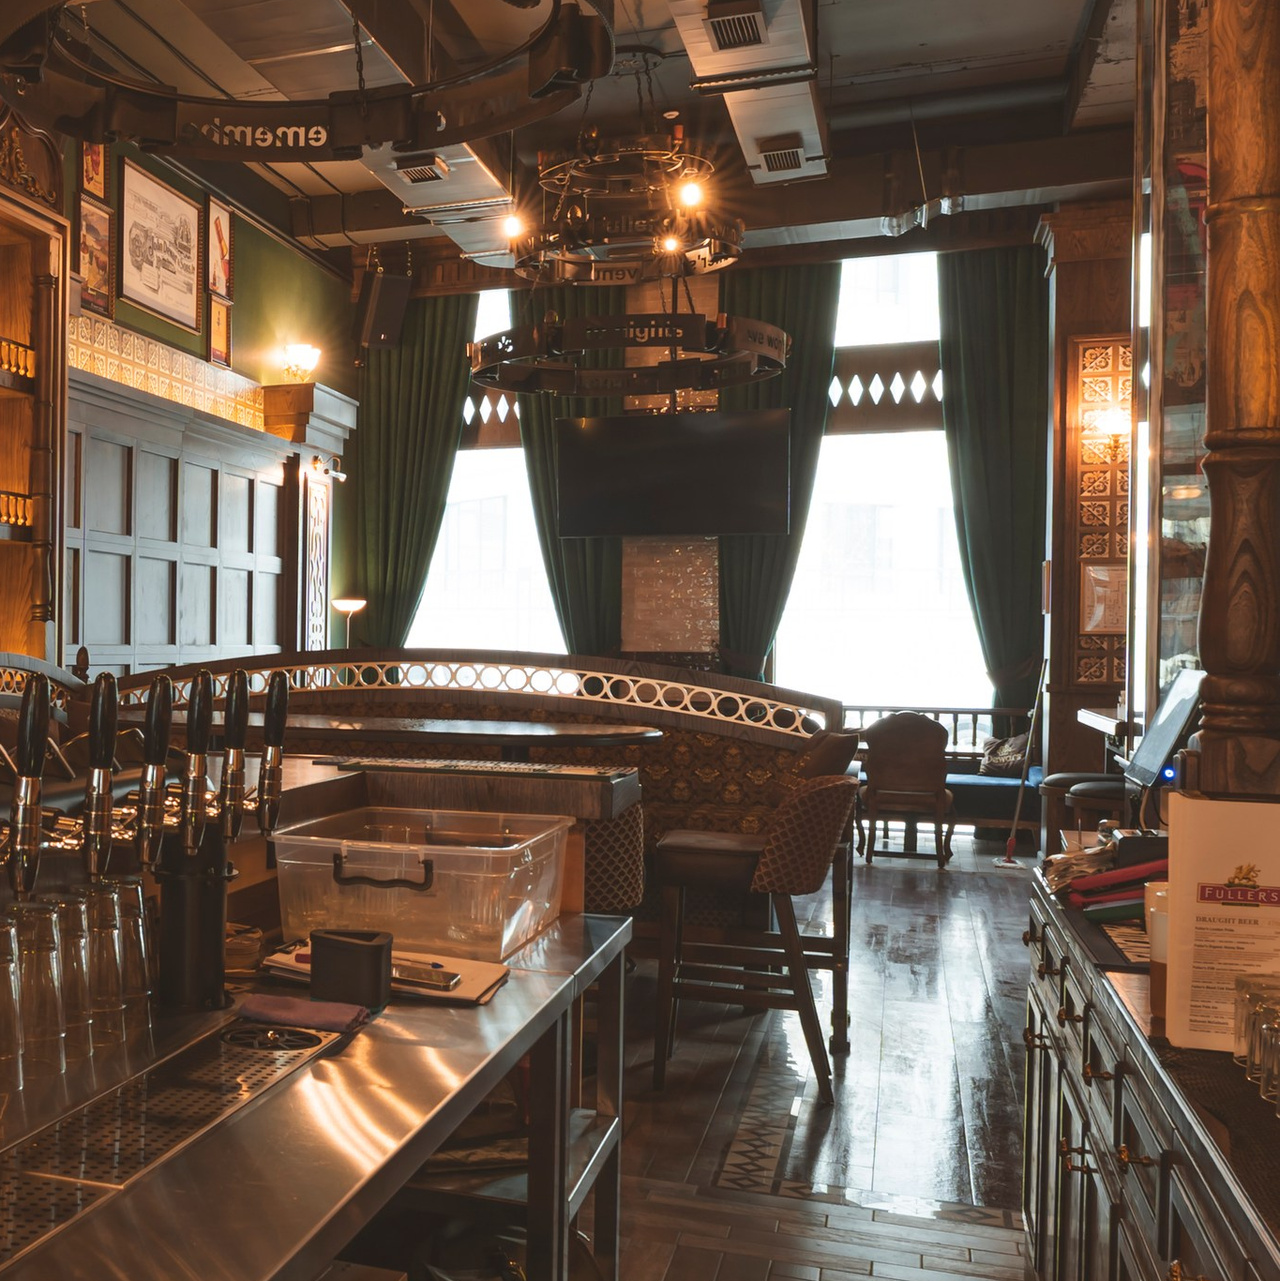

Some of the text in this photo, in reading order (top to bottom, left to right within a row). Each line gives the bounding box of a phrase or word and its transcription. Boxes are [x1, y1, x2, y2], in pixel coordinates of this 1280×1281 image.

[1205, 887, 1279, 902] FULLER'S
[1195, 916, 1260, 926] DRAUGHT BEER
